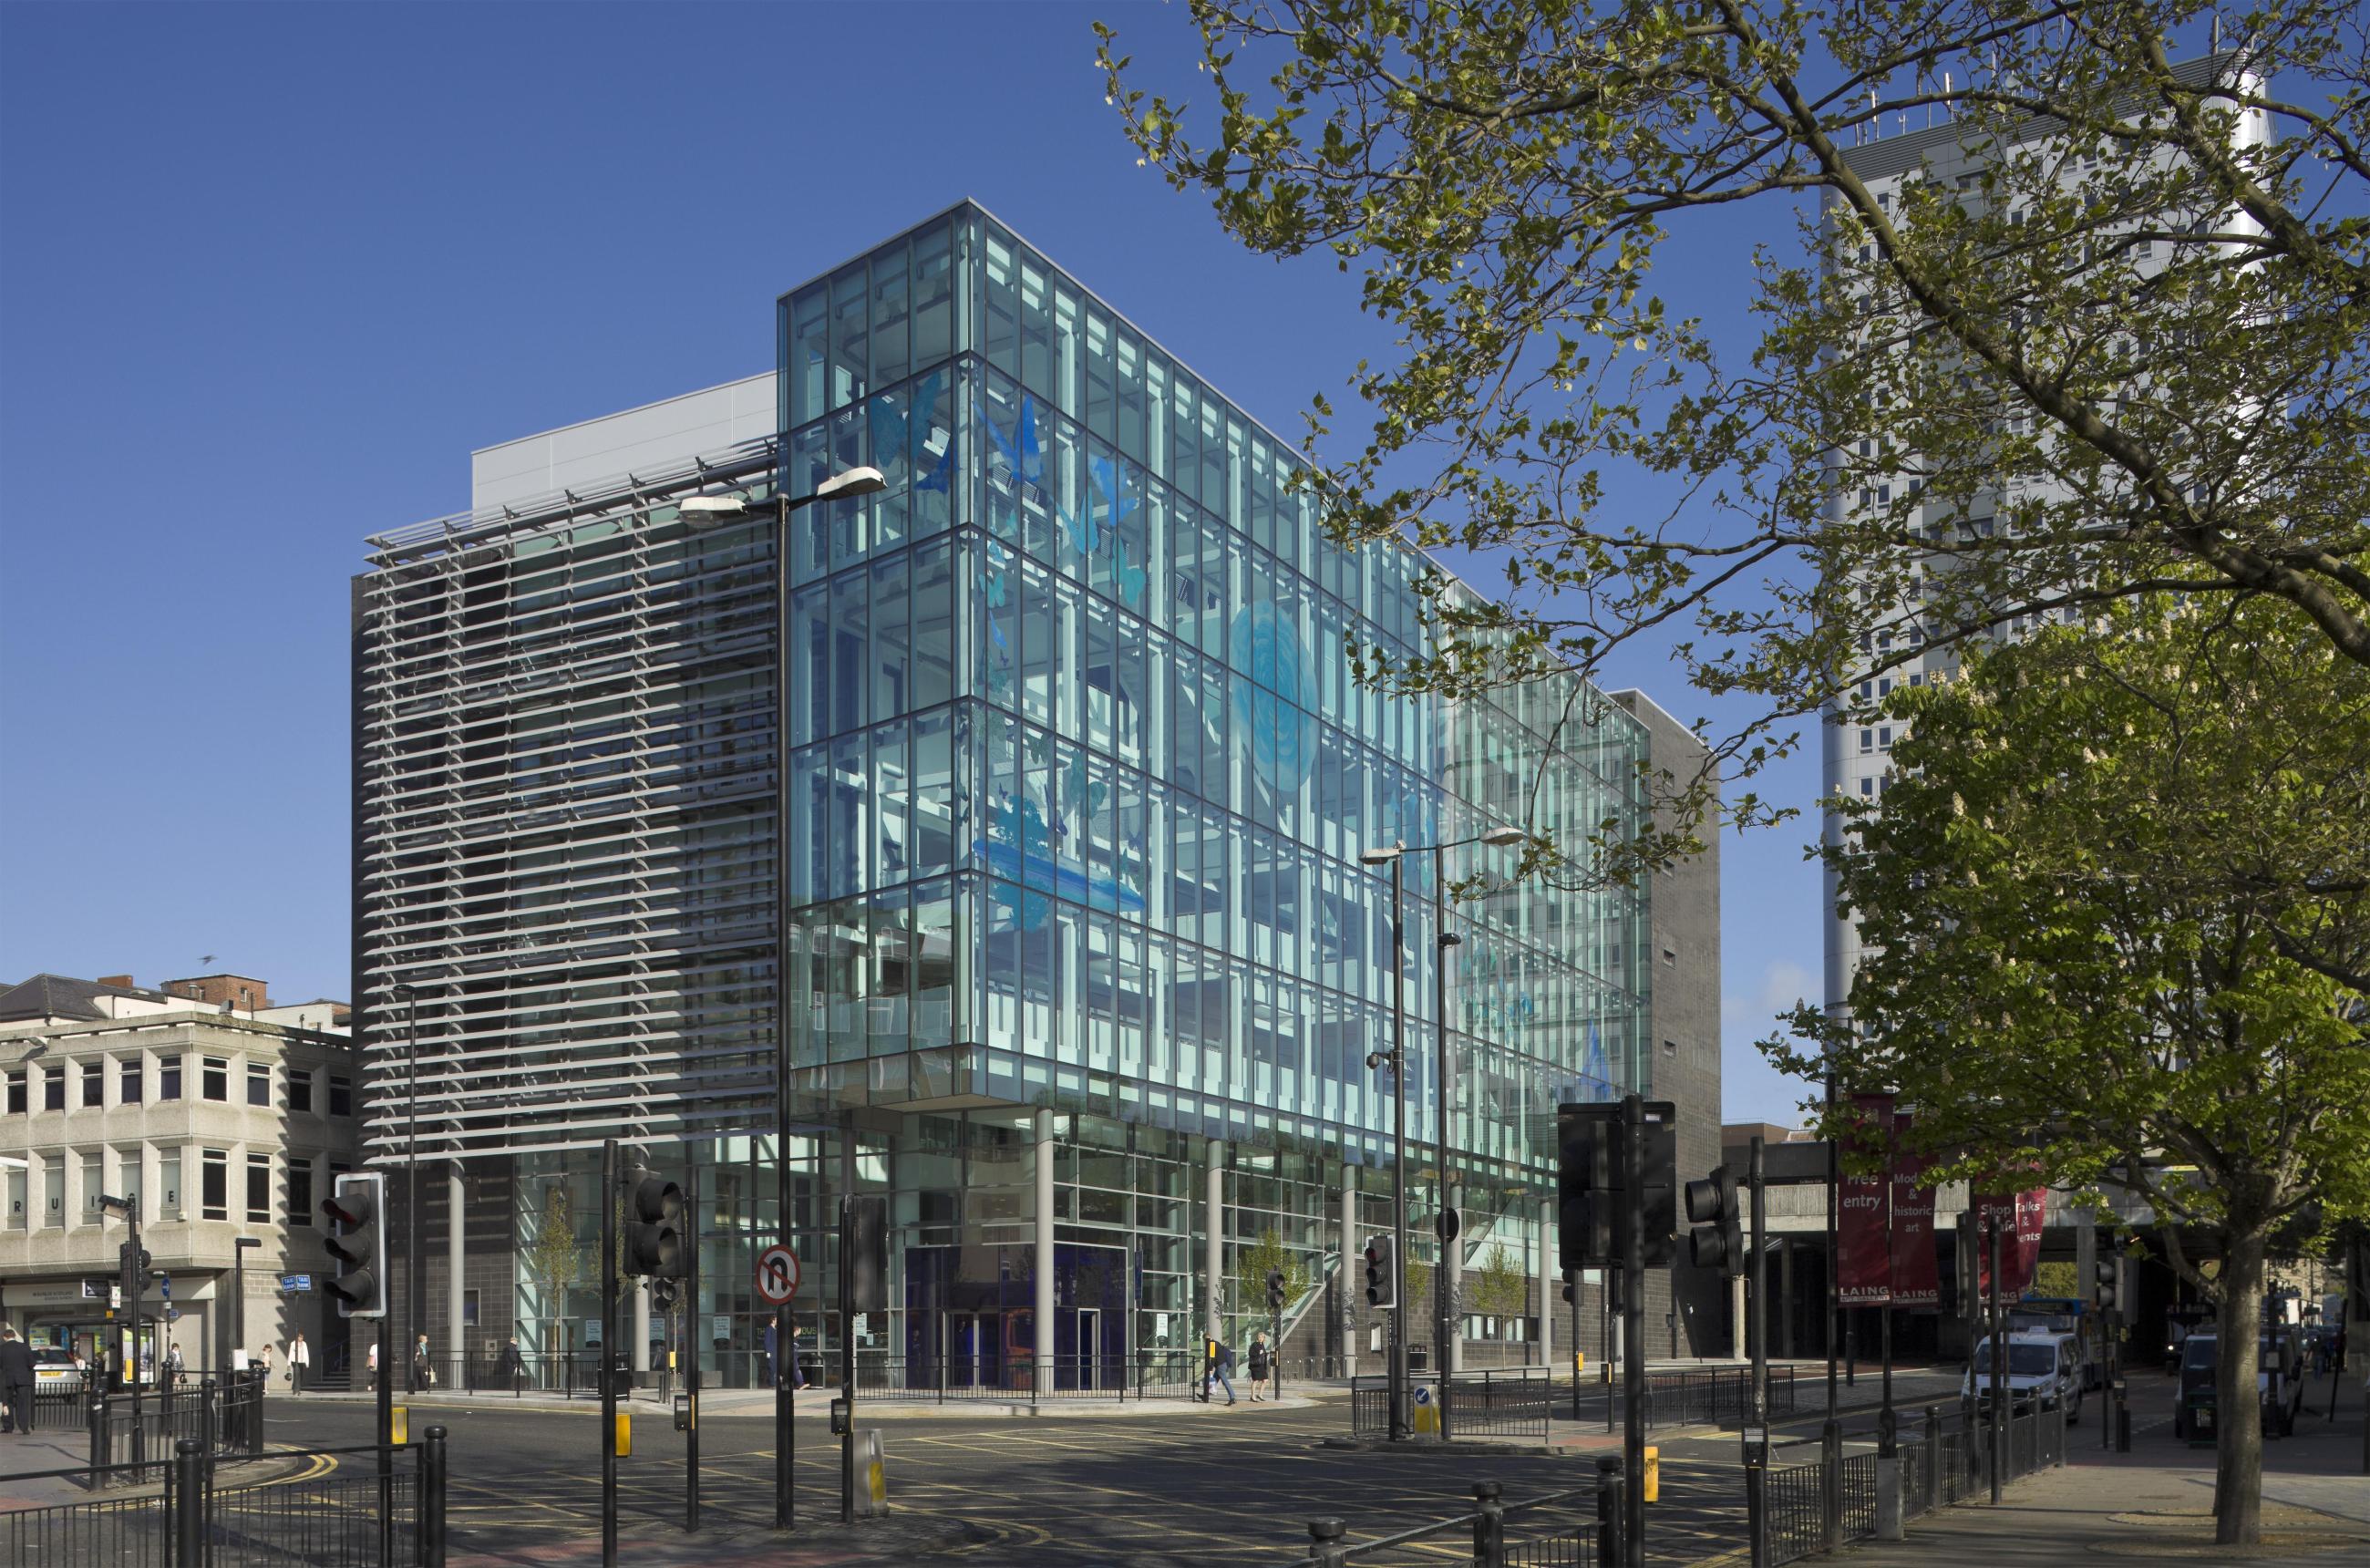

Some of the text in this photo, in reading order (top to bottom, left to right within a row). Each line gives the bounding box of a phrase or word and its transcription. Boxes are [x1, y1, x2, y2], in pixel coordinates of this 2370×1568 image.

[1908, 1188, 1918, 1200] &
[1843, 1194, 1881, 1211] entry
[1894, 1205, 1932, 1217] historic
[1981, 1203, 2011, 1217] Shop
[2022, 1216, 2030, 1226] &
[1905, 1222, 1920, 1233] art
[2017, 1232, 2041, 1243] ents
[1840, 1286, 1889, 1295] LAING
[1893, 1290, 1937, 1298] LAING
